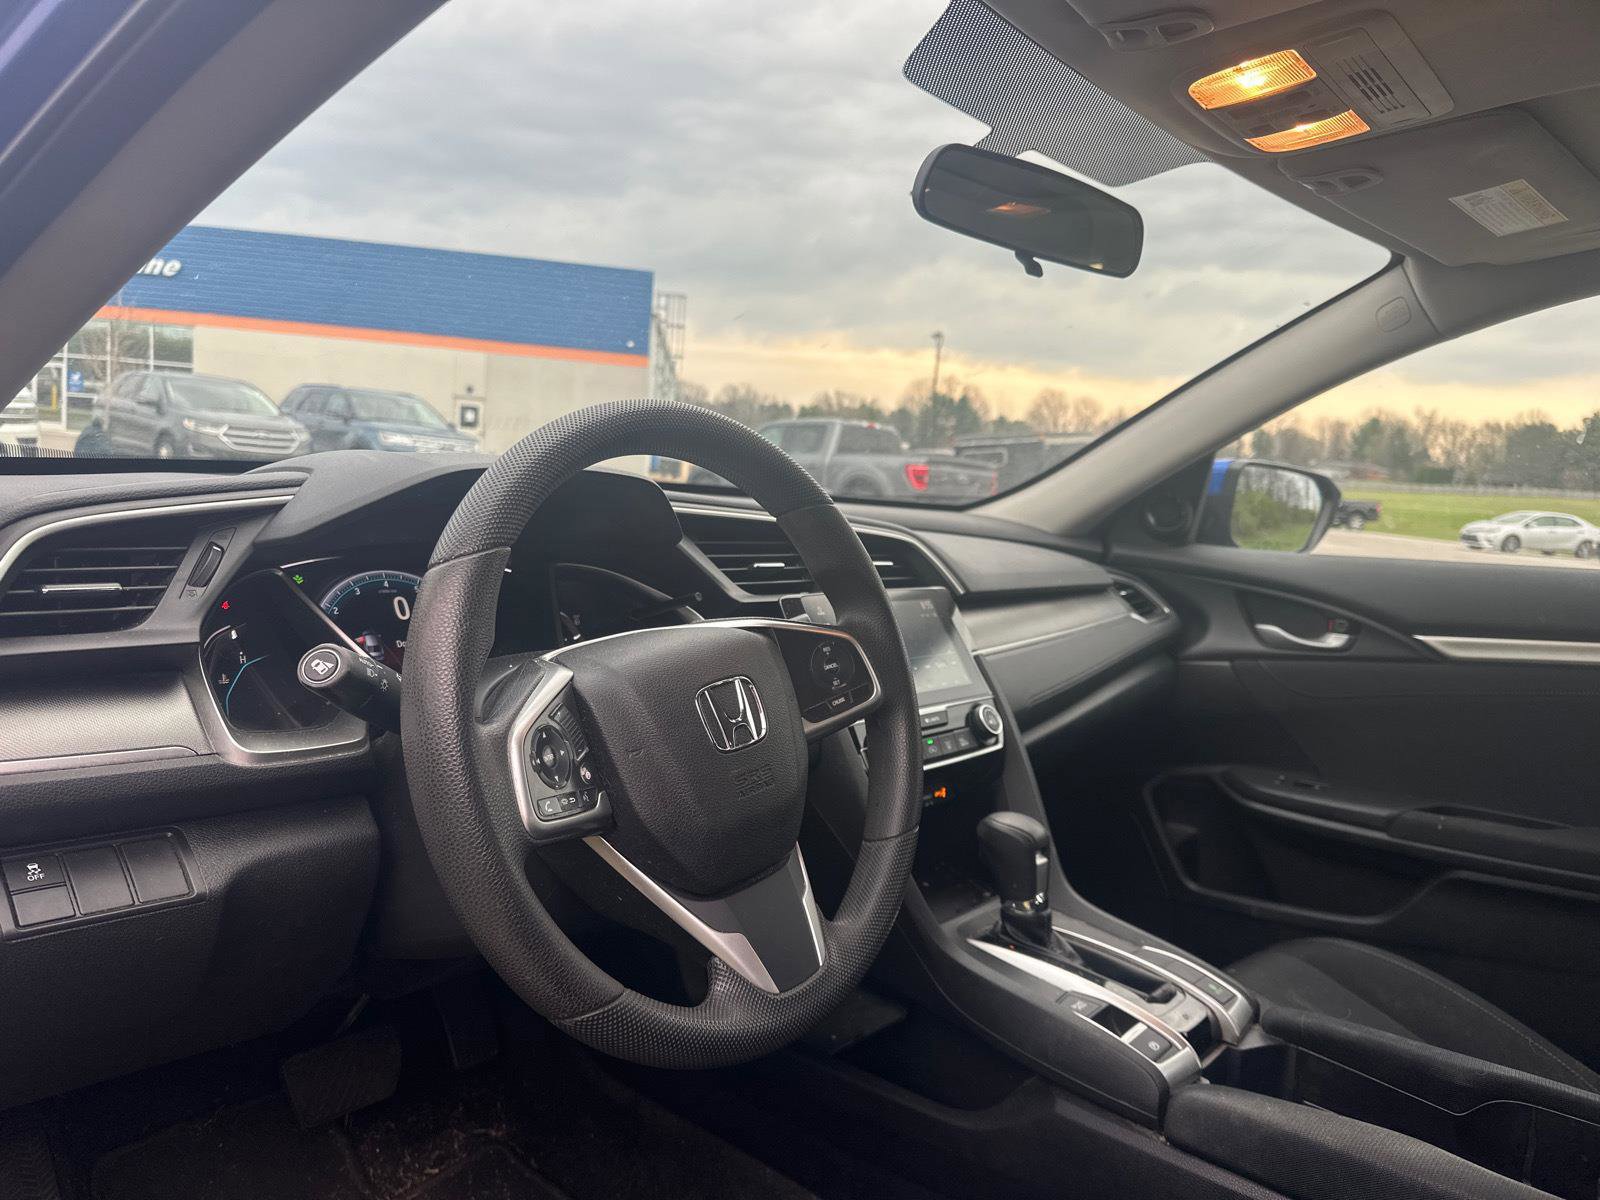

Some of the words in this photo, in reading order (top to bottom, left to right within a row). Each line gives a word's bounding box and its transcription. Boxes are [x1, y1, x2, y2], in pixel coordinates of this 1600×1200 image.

[137, 257, 182, 277] ne
[354, 587, 361, 595] 3
[333, 607, 340, 615] 2
[27, 872, 45, 882] OFF
